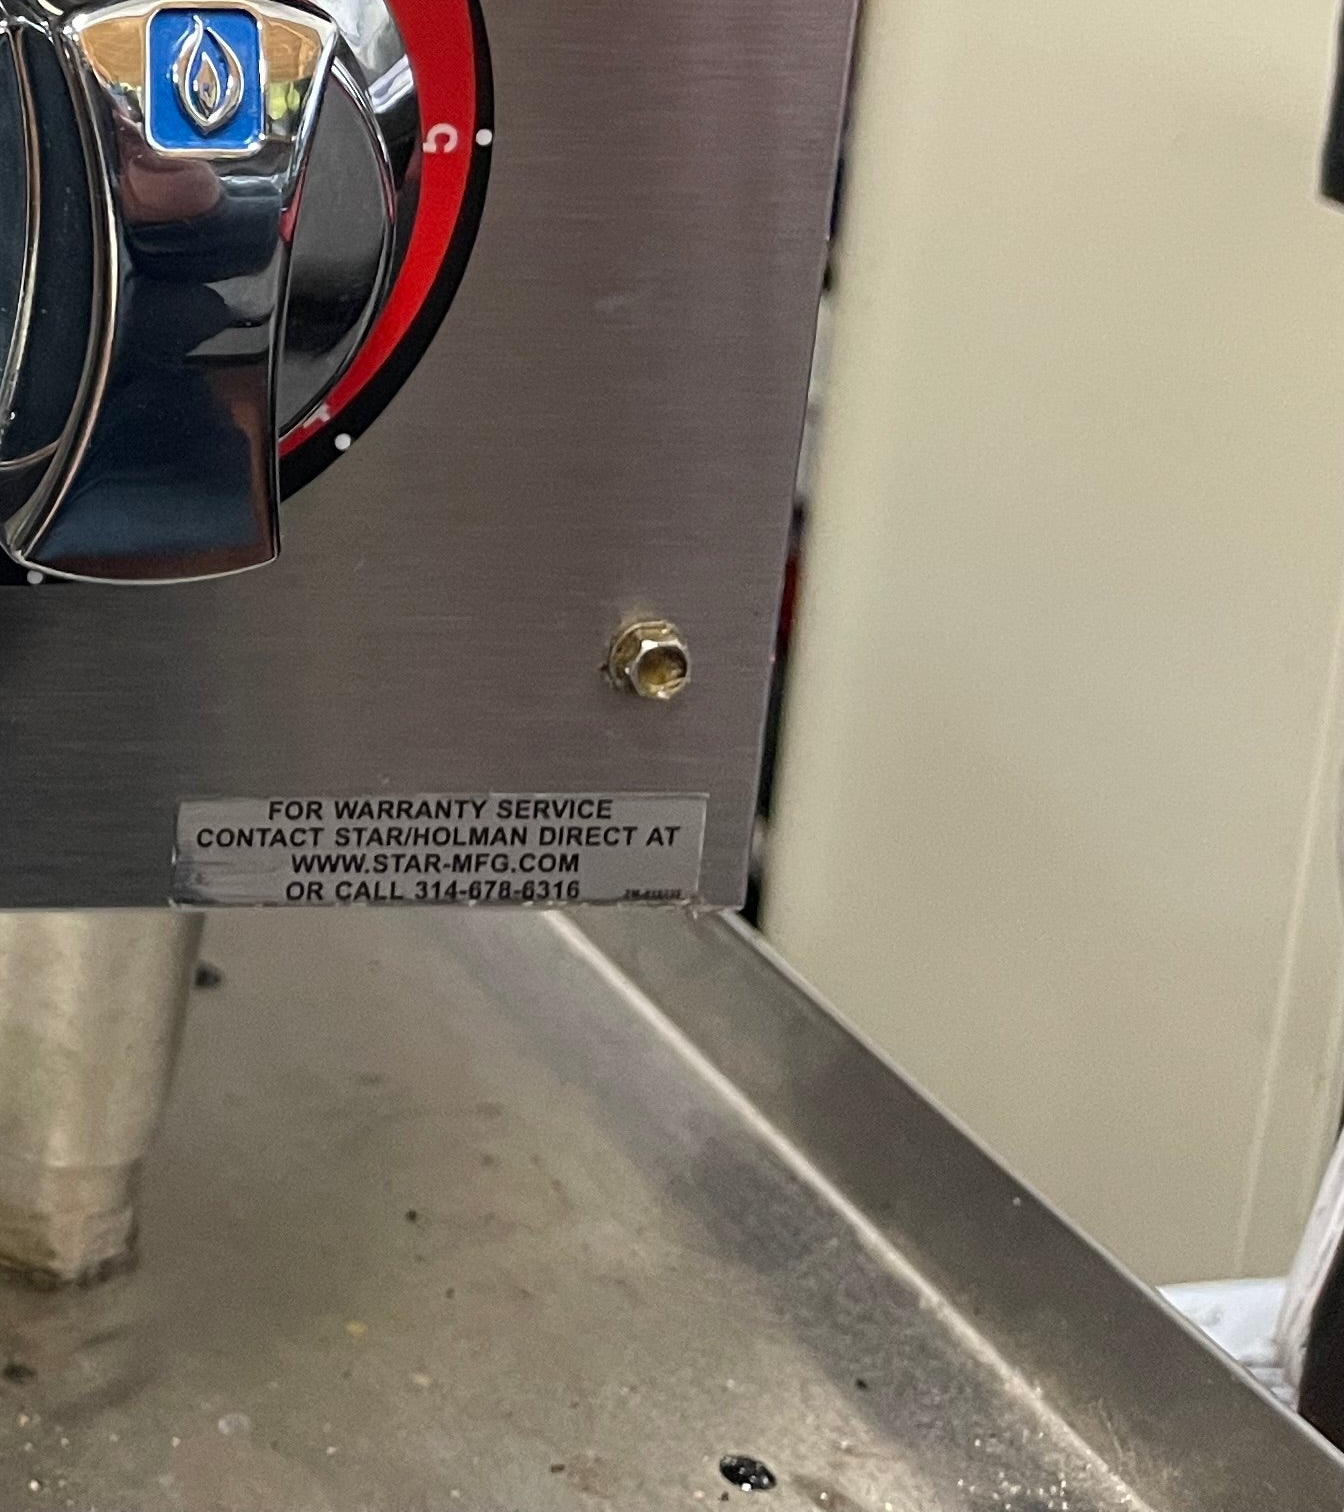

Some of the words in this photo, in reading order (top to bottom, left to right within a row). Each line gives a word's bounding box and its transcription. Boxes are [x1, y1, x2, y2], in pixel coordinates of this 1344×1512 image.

[268, 800, 323, 821] FOR
[334, 799, 487, 821] WARRANTY
[496, 799, 614, 820] SERVICE
[196, 827, 324, 848] CONTACT
[334, 826, 528, 848] STAR/HOLMAN
[538, 826, 638, 847] DIRECT
[645, 826, 681, 847] AT
[291, 852, 581, 874] WWW.STAR-MFG.COM
[285, 880, 324, 901] OR
[335, 880, 404, 901] CALL
[414, 880, 581, 901] 314-678-6316
